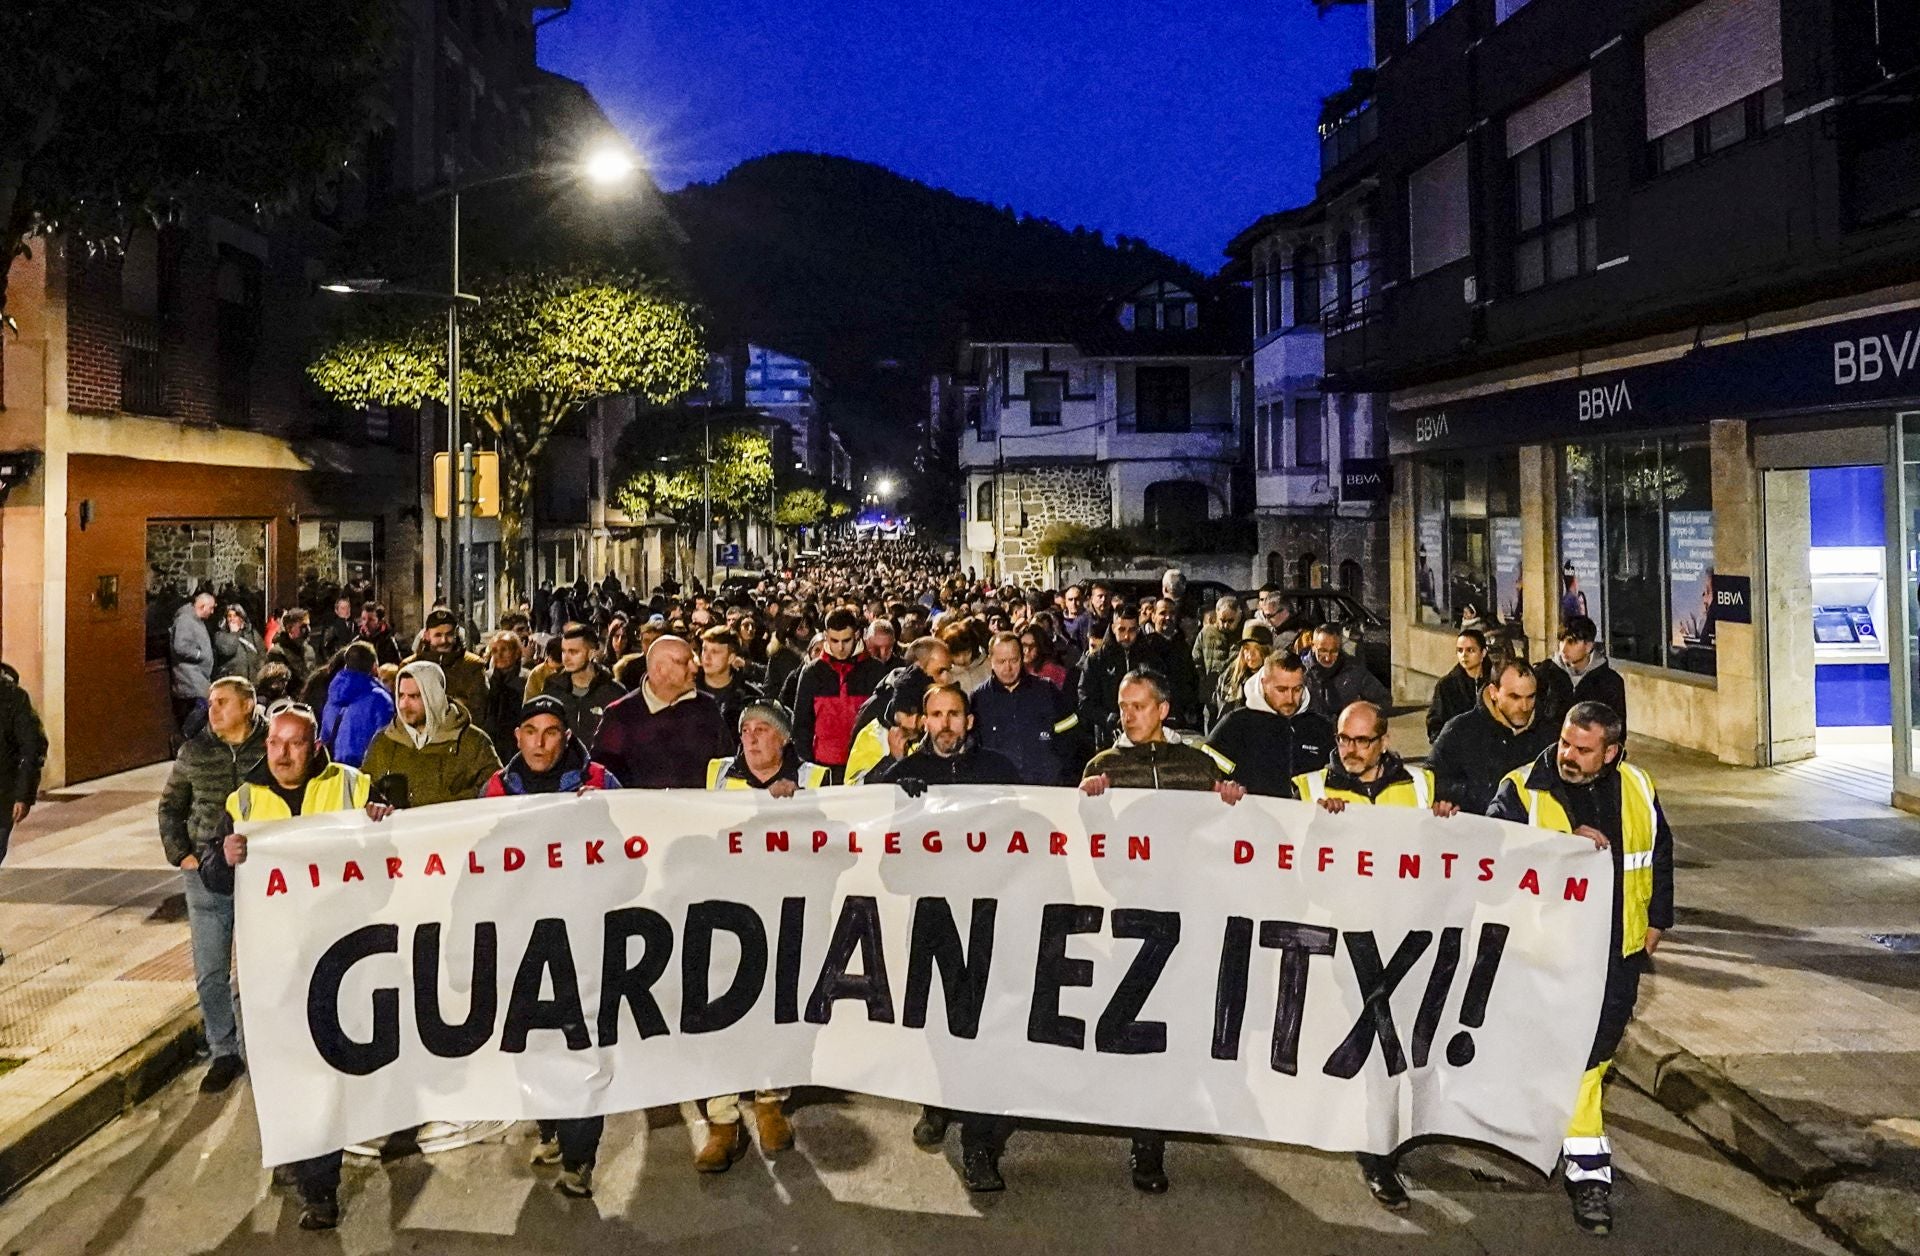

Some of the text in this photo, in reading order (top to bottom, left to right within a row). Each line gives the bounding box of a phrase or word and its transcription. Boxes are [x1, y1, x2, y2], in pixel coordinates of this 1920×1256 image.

[1579, 379, 1632, 421] BBVA
[1416, 411, 1448, 442] BBVA
[1346, 472, 1380, 485] BBVA
[1717, 590, 1744, 605] BBVA
[267, 831, 1588, 901] AIARALDEKO ENPLEGUAREN DEFENTSAN
[307, 896, 1509, 1079] GUARDIAN EZ ITXI!
